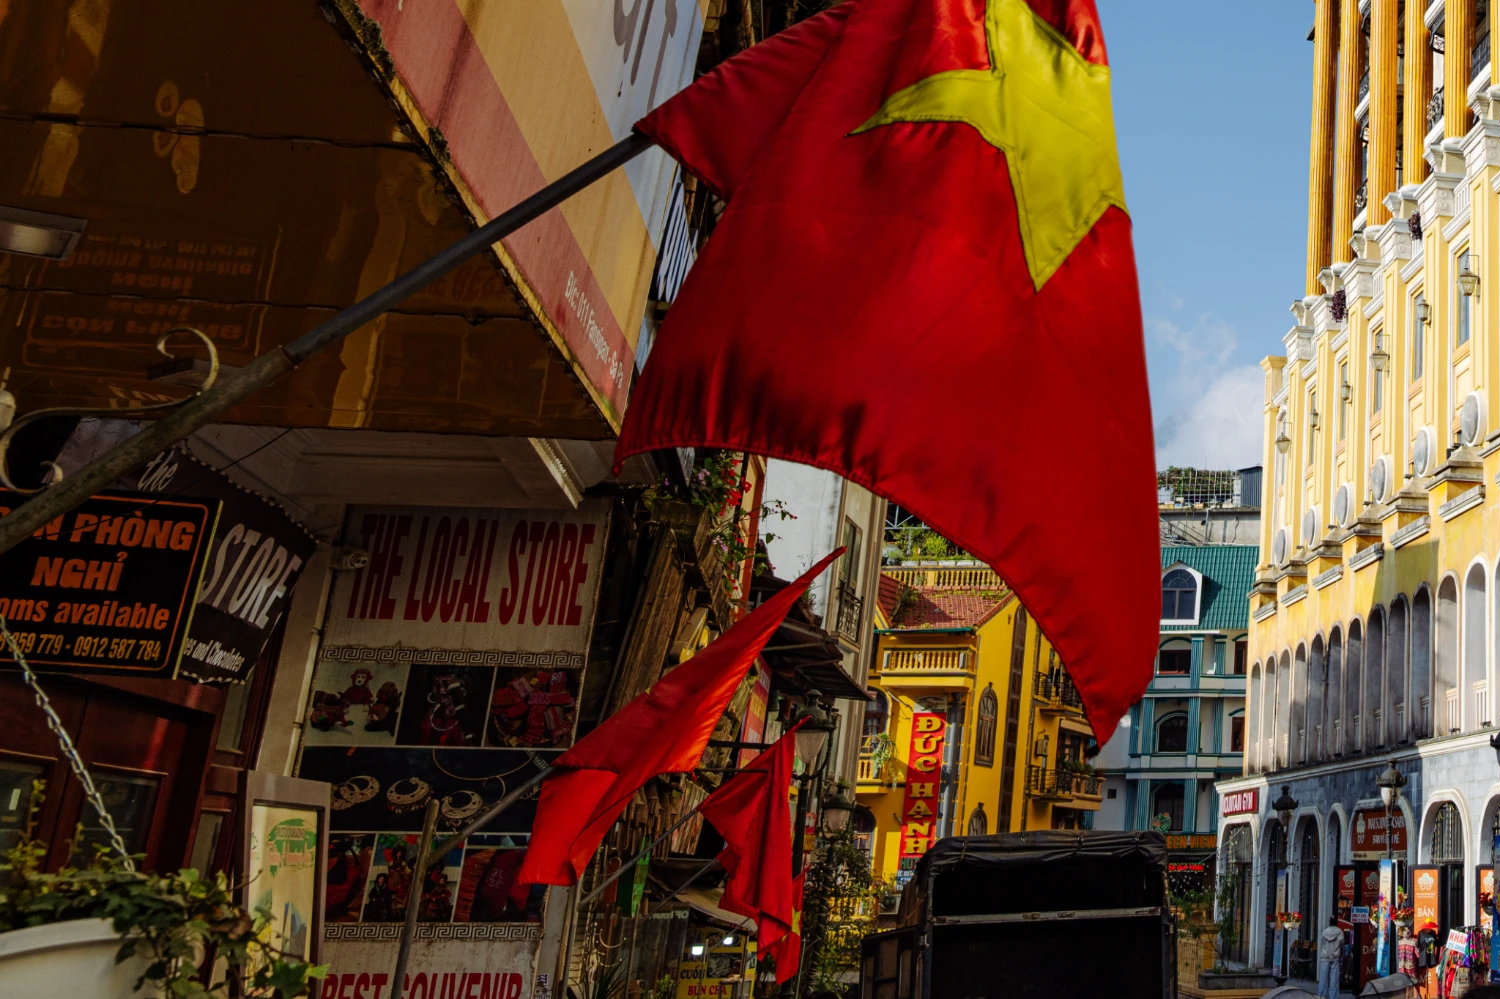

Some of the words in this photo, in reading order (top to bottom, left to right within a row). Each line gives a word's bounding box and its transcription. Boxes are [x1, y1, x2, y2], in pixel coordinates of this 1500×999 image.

[137, 450, 179, 492] the
[70, 510, 196, 552] PHÒNG
[30, 550, 129, 592] NGHỈ
[198, 522, 303, 630] STORE
[347, 513, 412, 620] THE
[403, 515, 499, 624] LOCAL
[499, 518, 596, 627] STORE
[0, 597, 49, 622] oms
[53, 600, 171, 631] available
[36, 633, 65, 655] 779
[73, 635, 109, 658] 0912
[108, 637, 137, 660] 587
[136, 639, 162, 662] 784
[913, 715, 943, 773] ĐỨC
[902, 781, 936, 855] HẠNH
[1166, 835, 1187, 849] EEN
[1189, 835, 1217, 849] VIEW
[321, 972, 389, 999] BEST
